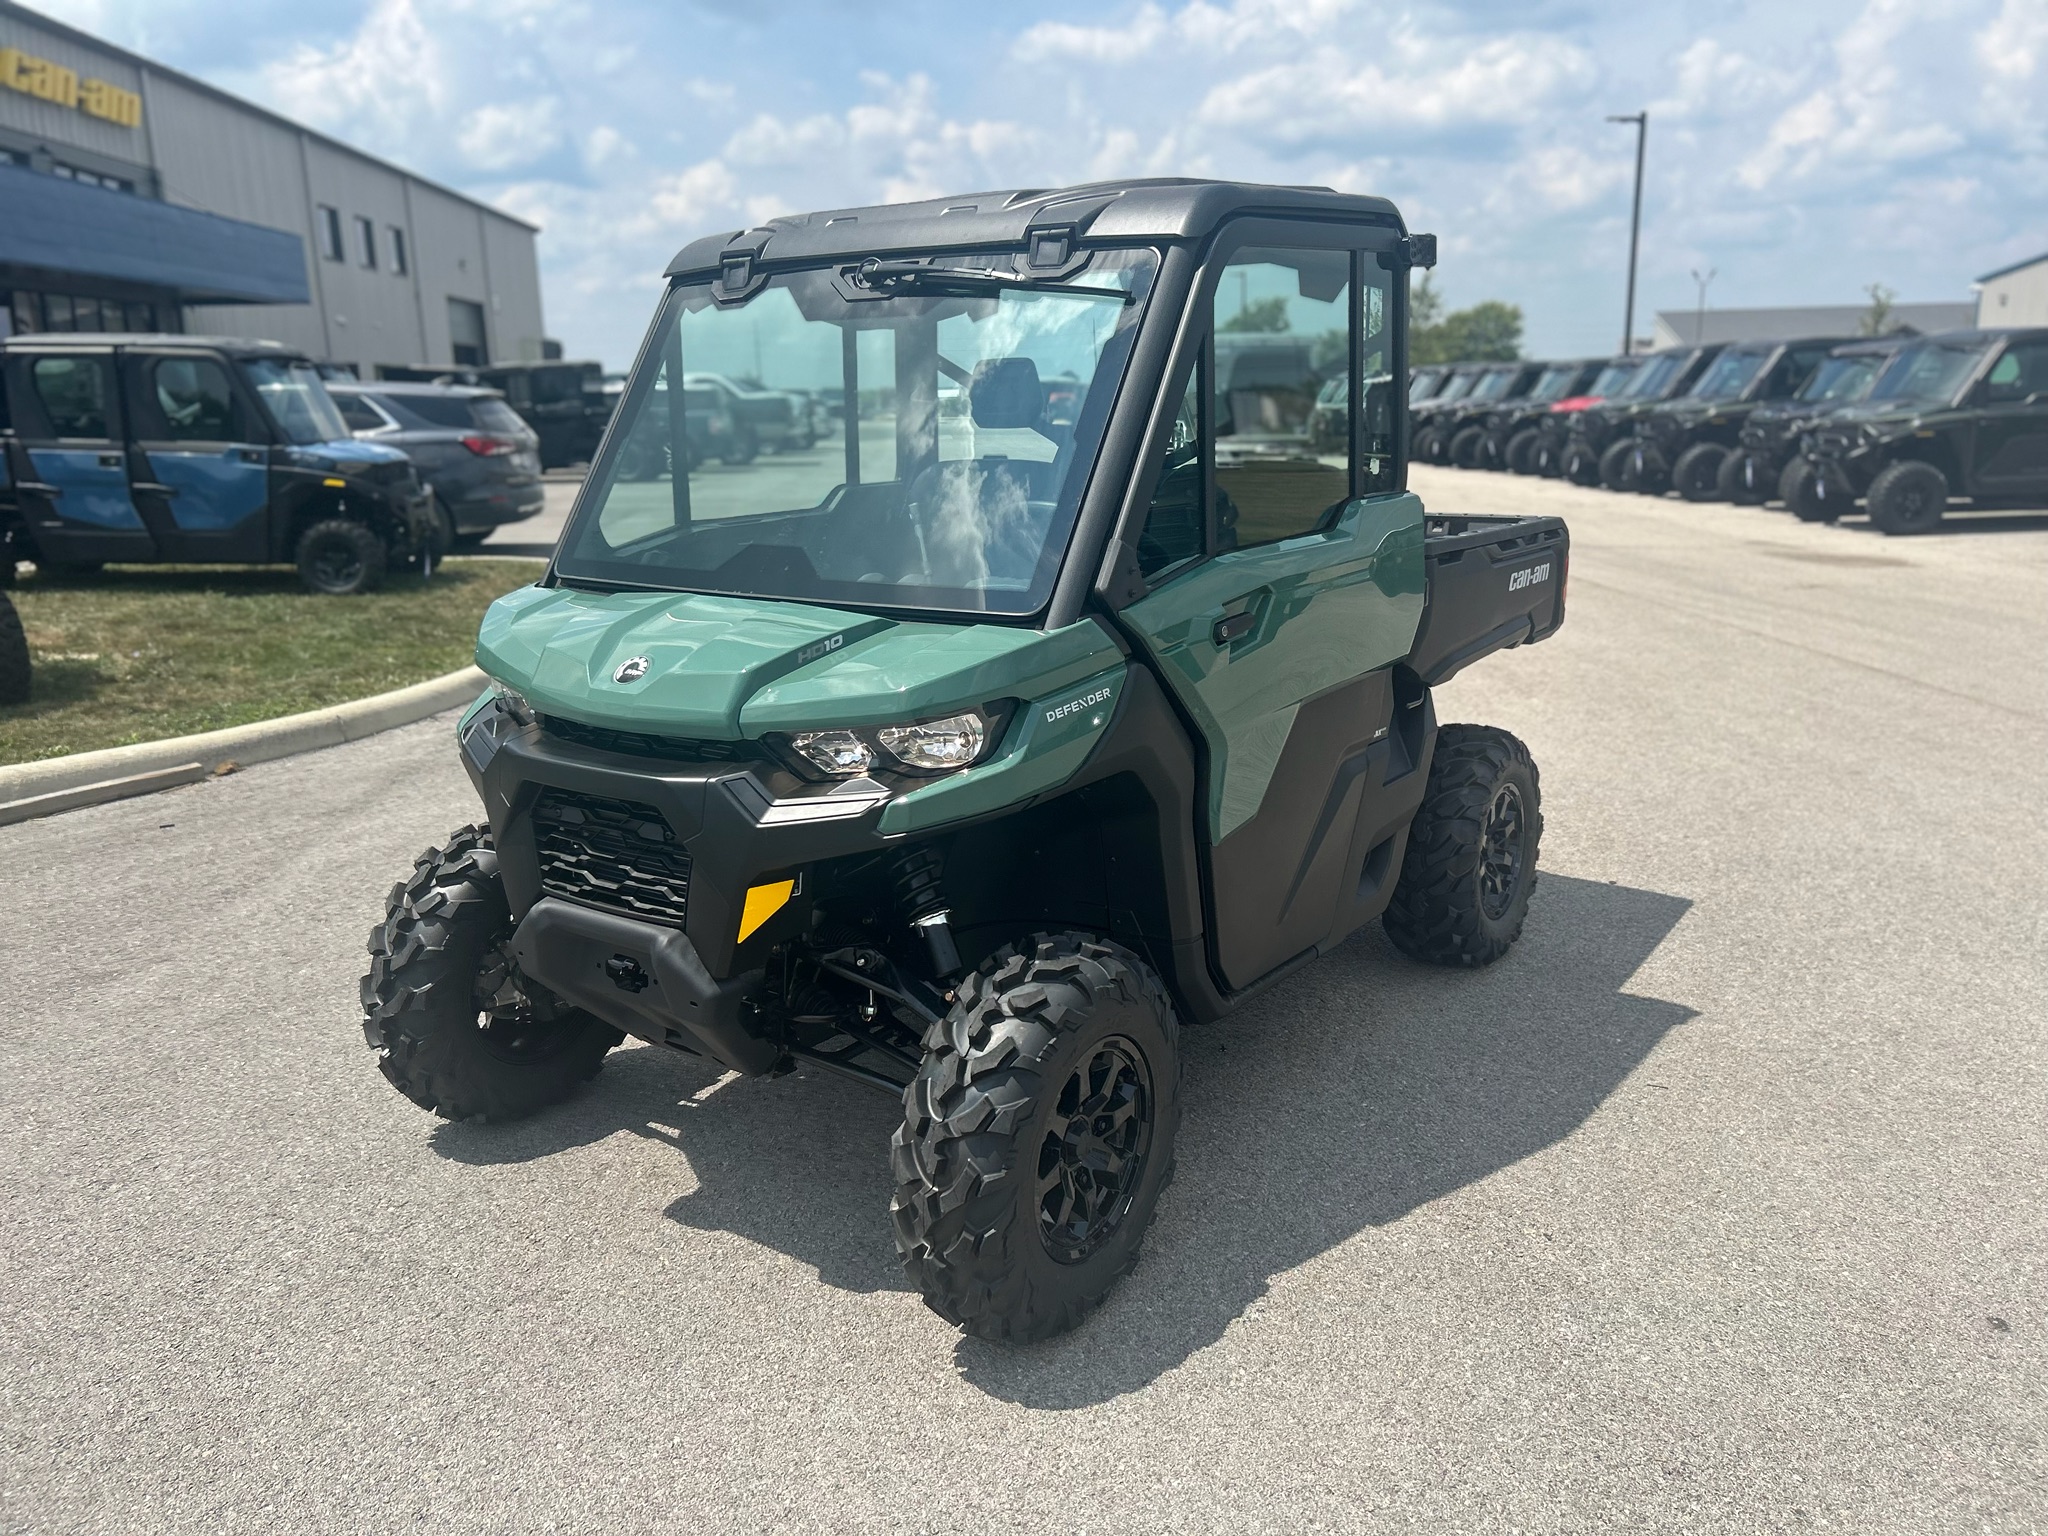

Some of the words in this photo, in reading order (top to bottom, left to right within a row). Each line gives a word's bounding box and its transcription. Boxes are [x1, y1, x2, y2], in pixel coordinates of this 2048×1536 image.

[0, 48, 141, 128] can-am
[1509, 563, 1550, 592] can-am
[798, 634, 843, 664] HD10
[1045, 687, 1111, 723] DEFENDER
